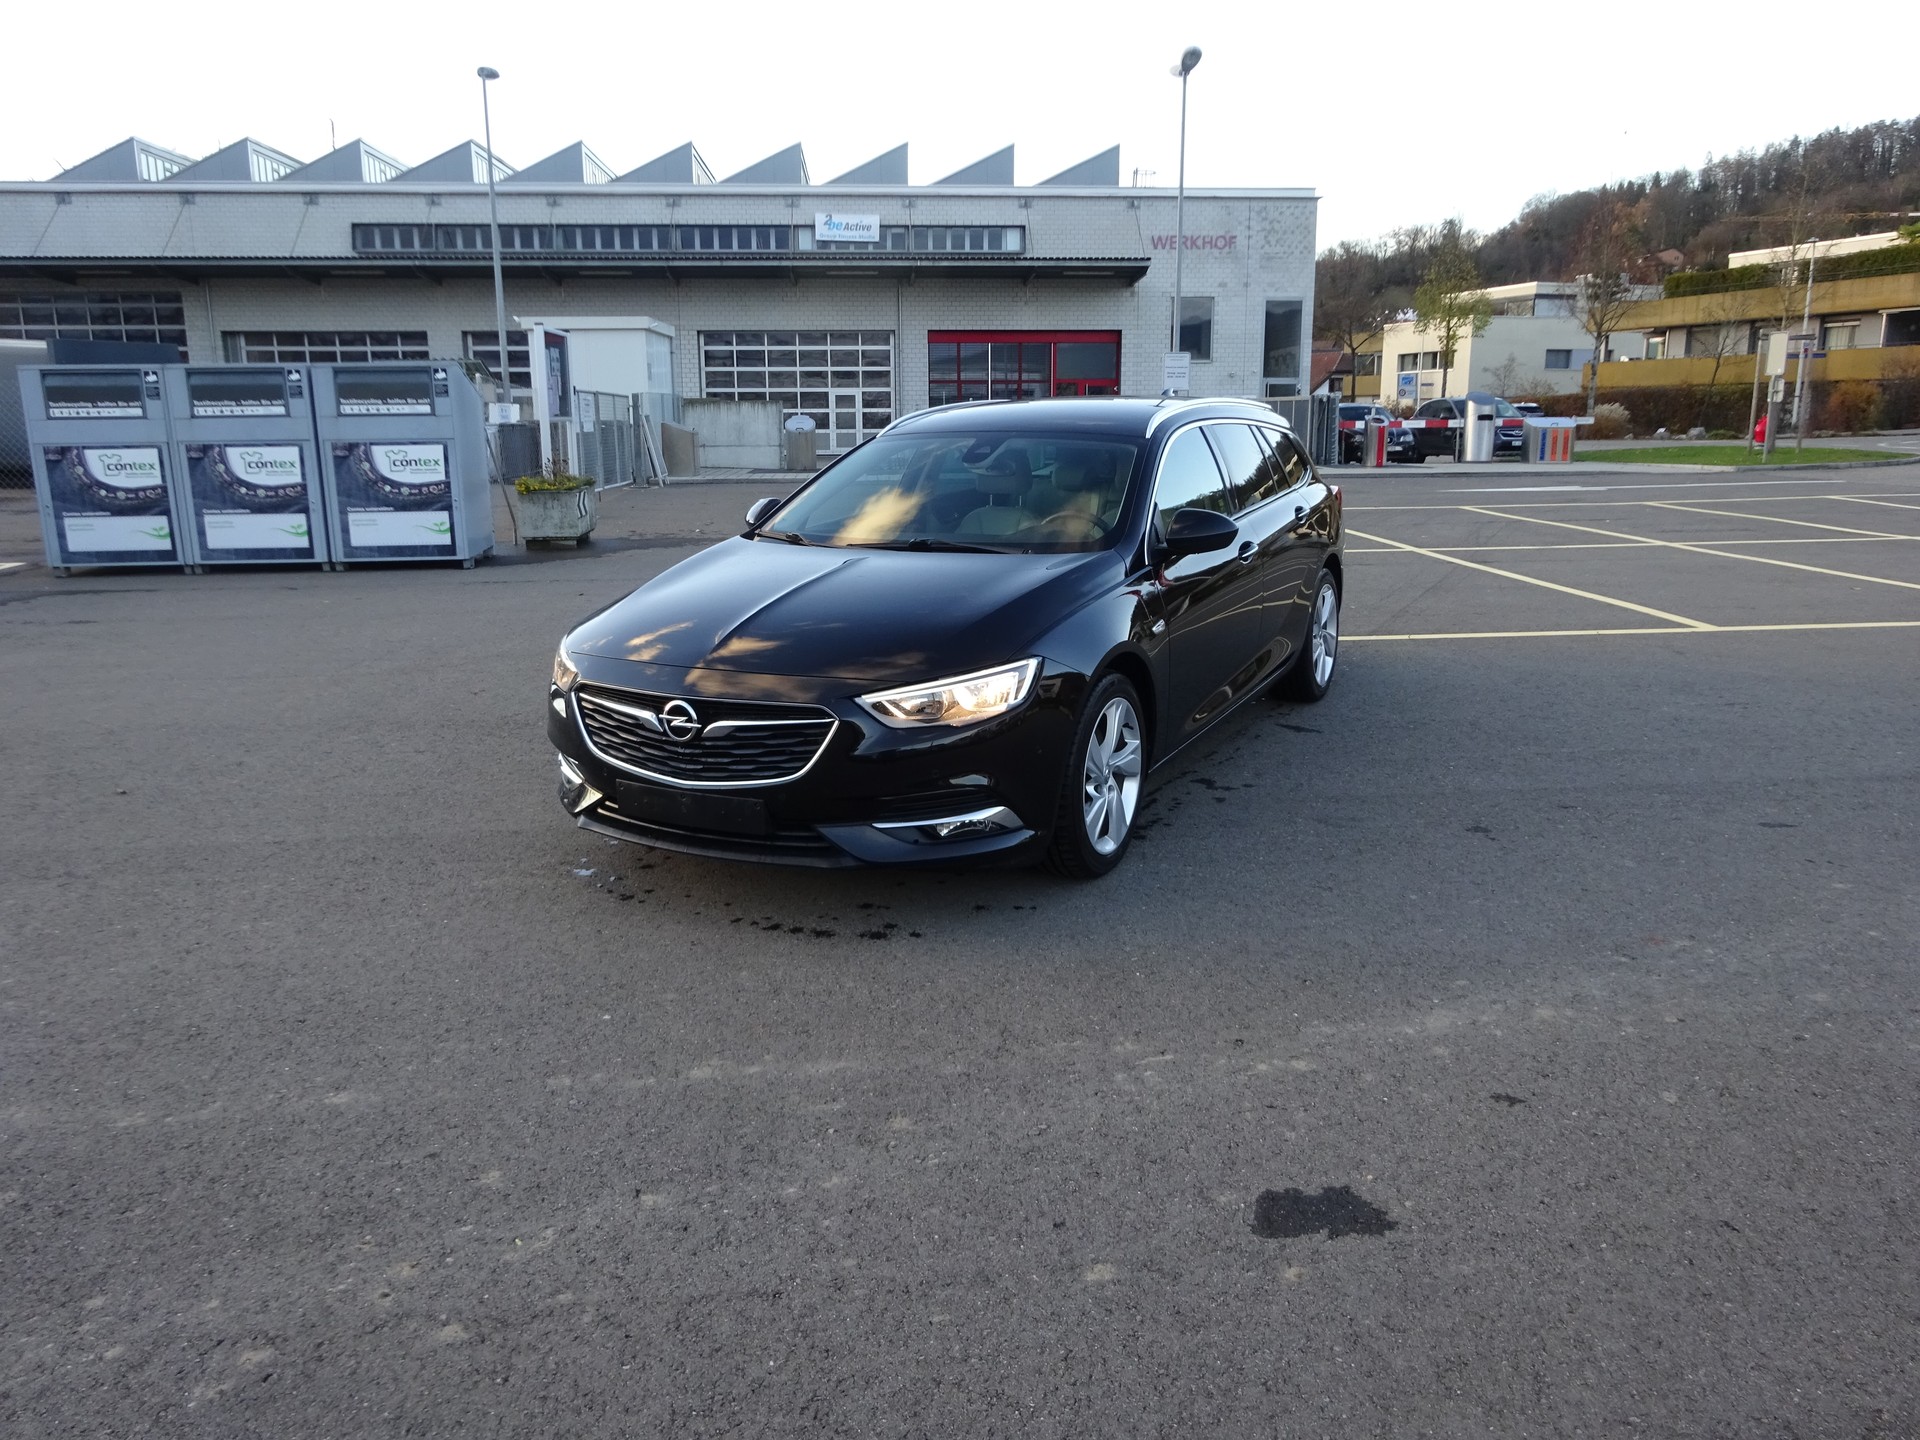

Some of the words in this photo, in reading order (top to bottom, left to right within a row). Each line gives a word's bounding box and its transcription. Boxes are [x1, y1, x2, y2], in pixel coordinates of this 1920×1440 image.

[843, 220, 872, 232] Active
[1151, 235, 1237, 250] WERKHOF
[106, 461, 156, 471] contex
[247, 459, 297, 469] contex
[392, 458, 441, 467] contex
